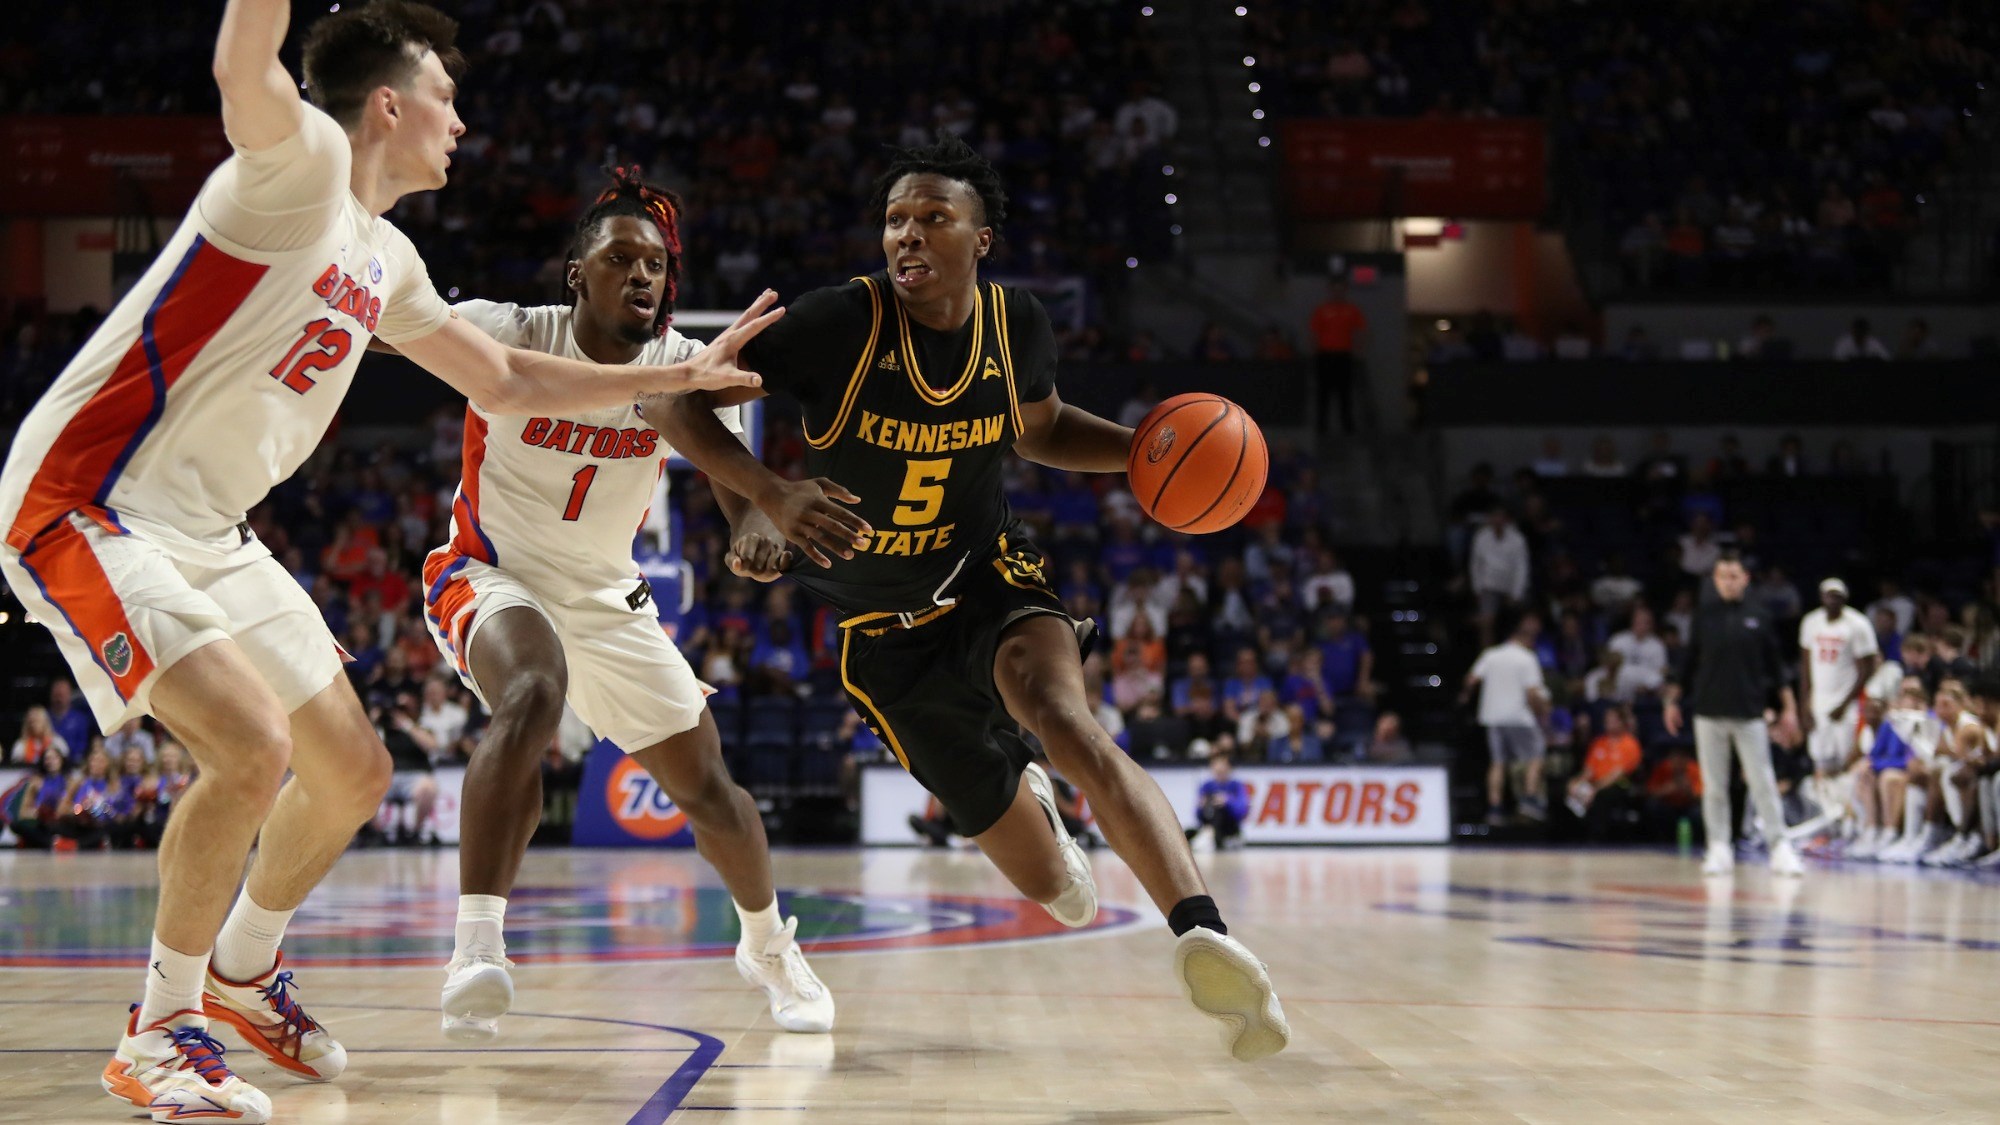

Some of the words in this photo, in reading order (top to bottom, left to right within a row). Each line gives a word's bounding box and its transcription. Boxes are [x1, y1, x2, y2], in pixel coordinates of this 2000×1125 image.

[269, 318, 351, 395] 12
[521, 417, 660, 459] GATORS
[856, 409, 1005, 453] KENNESAW
[562, 464, 598, 521] 1
[892, 458, 953, 525] 5
[852, 523, 955, 556] STATE
[1243, 779, 1421, 826] ATORS
